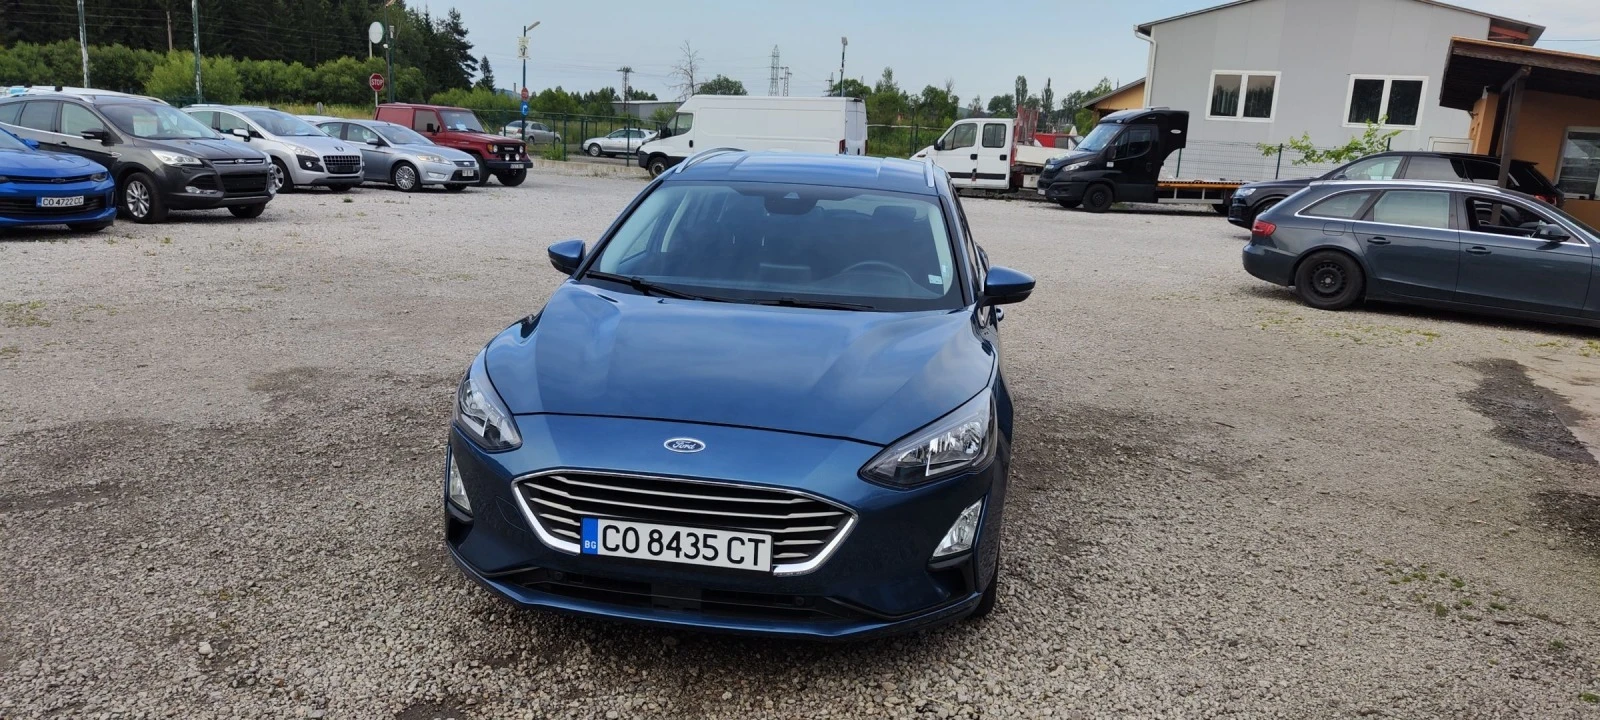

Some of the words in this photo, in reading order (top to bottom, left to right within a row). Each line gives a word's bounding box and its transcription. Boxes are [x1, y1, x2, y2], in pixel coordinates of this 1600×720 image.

[371, 78, 383, 86] STOP
[55, 198, 73, 206] 4722
[672, 439, 696, 450] Ford
[584, 540, 597, 549] BG
[602, 525, 640, 554] CO
[647, 529, 719, 561] 8435
[727, 536, 766, 566] CT
